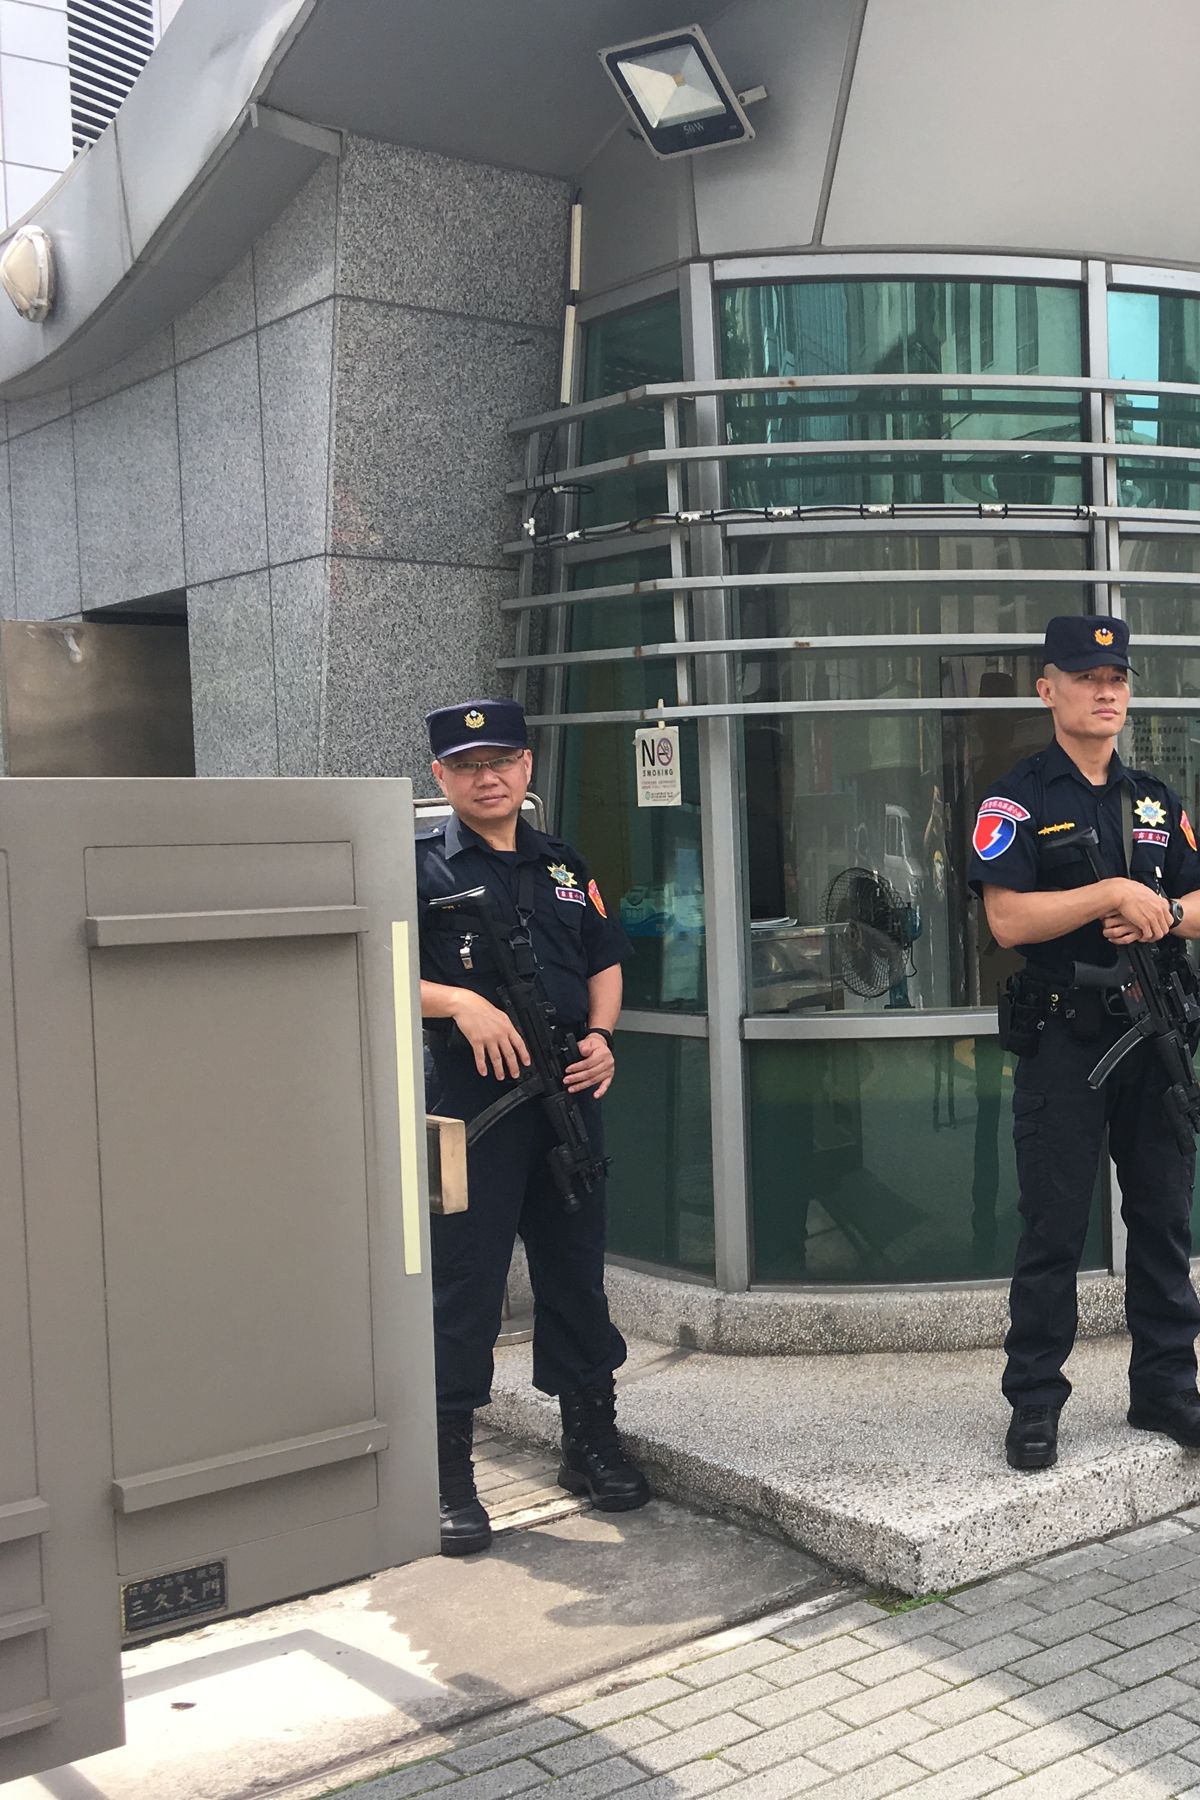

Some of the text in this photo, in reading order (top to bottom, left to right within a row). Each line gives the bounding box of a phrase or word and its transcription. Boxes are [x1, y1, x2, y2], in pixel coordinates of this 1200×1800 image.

[683, 122, 704, 135] 50W
[642, 768, 674, 777] SMOKING
[129, 1578, 220, 1618] 三久大門
